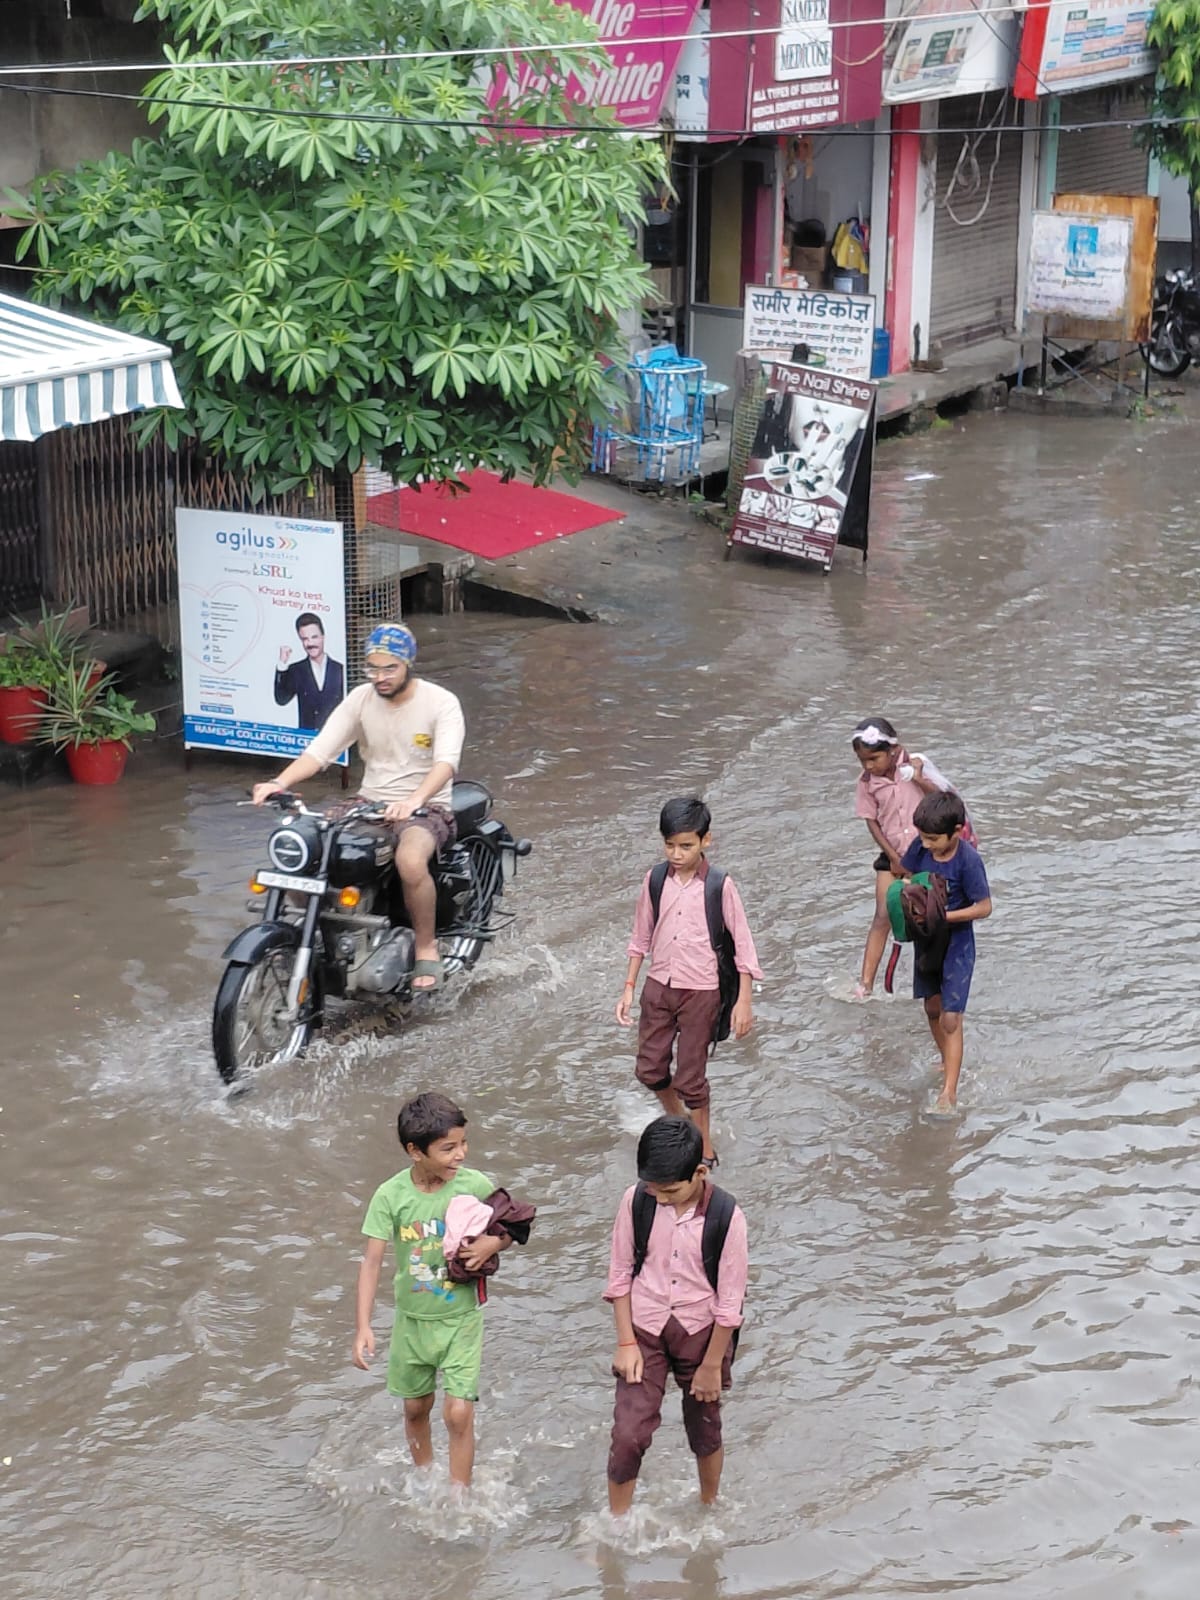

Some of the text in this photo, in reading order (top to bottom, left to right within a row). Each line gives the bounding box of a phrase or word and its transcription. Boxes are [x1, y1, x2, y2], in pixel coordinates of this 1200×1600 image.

[752, 290, 792, 314] समीर
[776, 366, 800, 383] The
[803, 372, 831, 392] Nail
[832, 380, 870, 400] Shine
[216, 527, 275, 551] agilus
[261, 564, 293, 579] SRL
[258, 584, 322, 601] Khud ko test
[272, 596, 331, 612] kartey raho
[194, 724, 235, 737] RAMESH
[236, 729, 296, 745] COLLECTION
